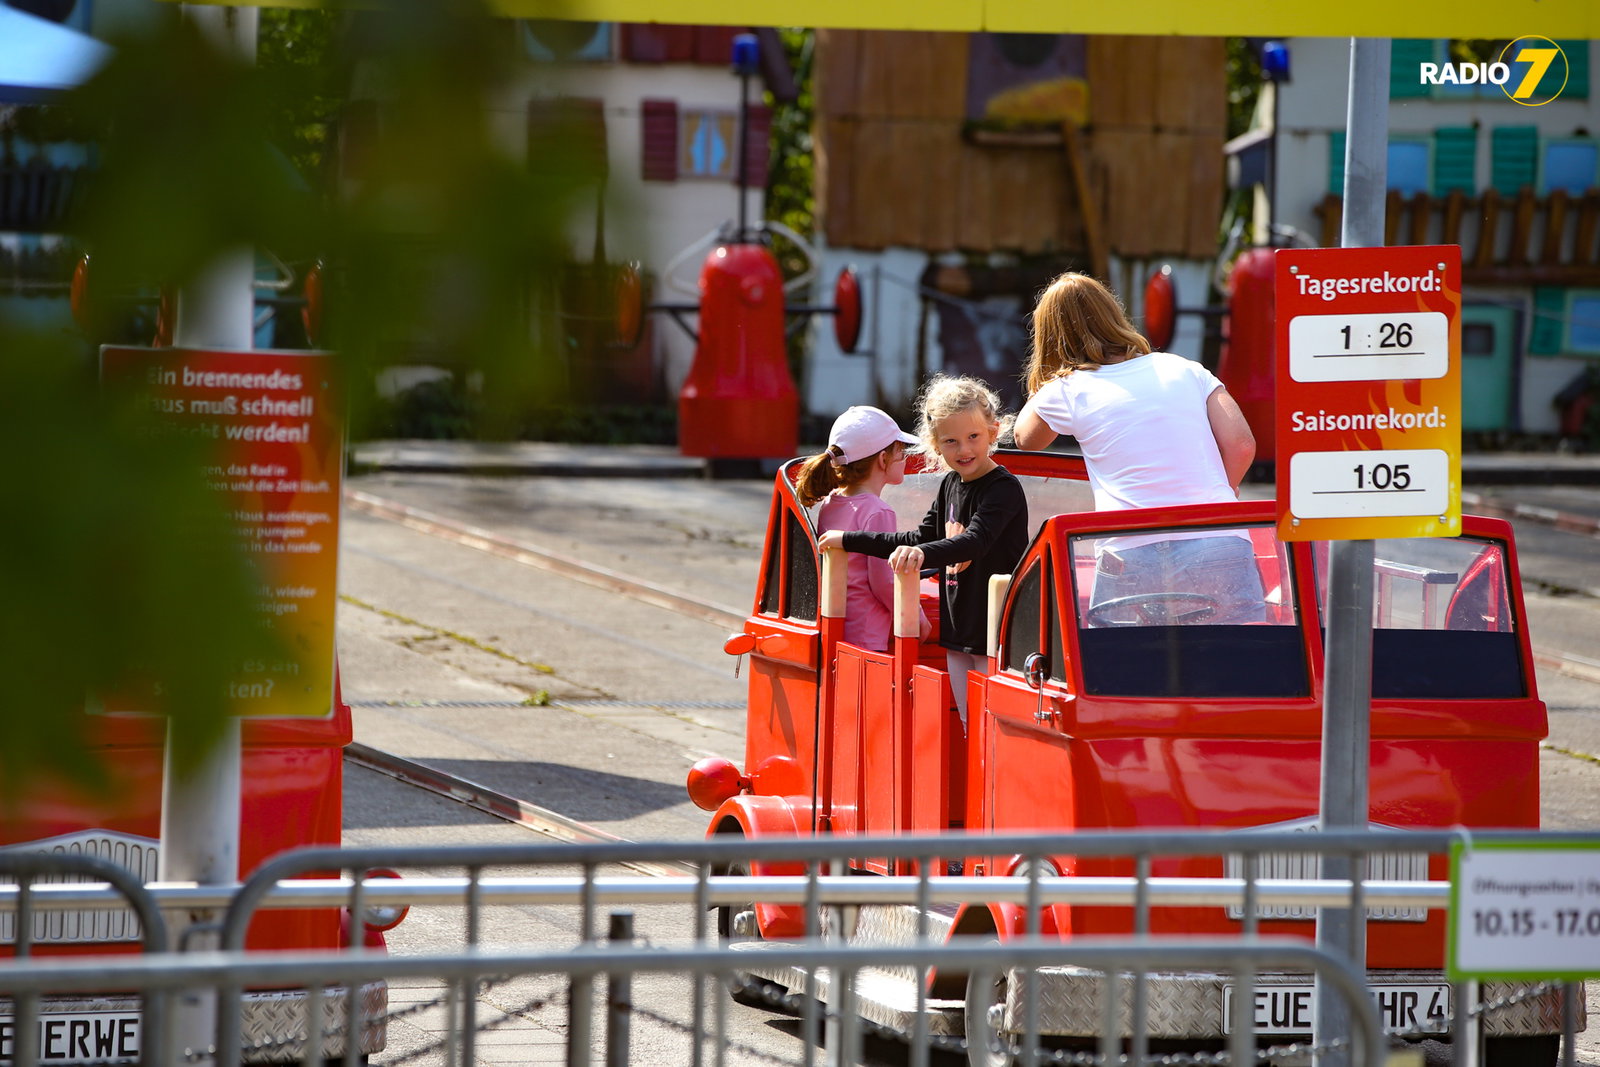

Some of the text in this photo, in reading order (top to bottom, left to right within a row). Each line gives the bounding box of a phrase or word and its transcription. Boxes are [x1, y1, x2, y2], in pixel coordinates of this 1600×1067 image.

[1296, 270, 1441, 301] Tagesrekord:
[182, 366, 303, 391] brennendes
[190, 396, 238, 415] muß
[241, 394, 314, 417] schnell
[1292, 406, 1447, 431] Saisonrekord:
[224, 421, 310, 443] werden!
[227, 464, 248, 476] das
[1353, 463, 1411, 490] 1:05
[231, 480, 254, 492] und
[1473, 907, 1535, 937] 10.15
